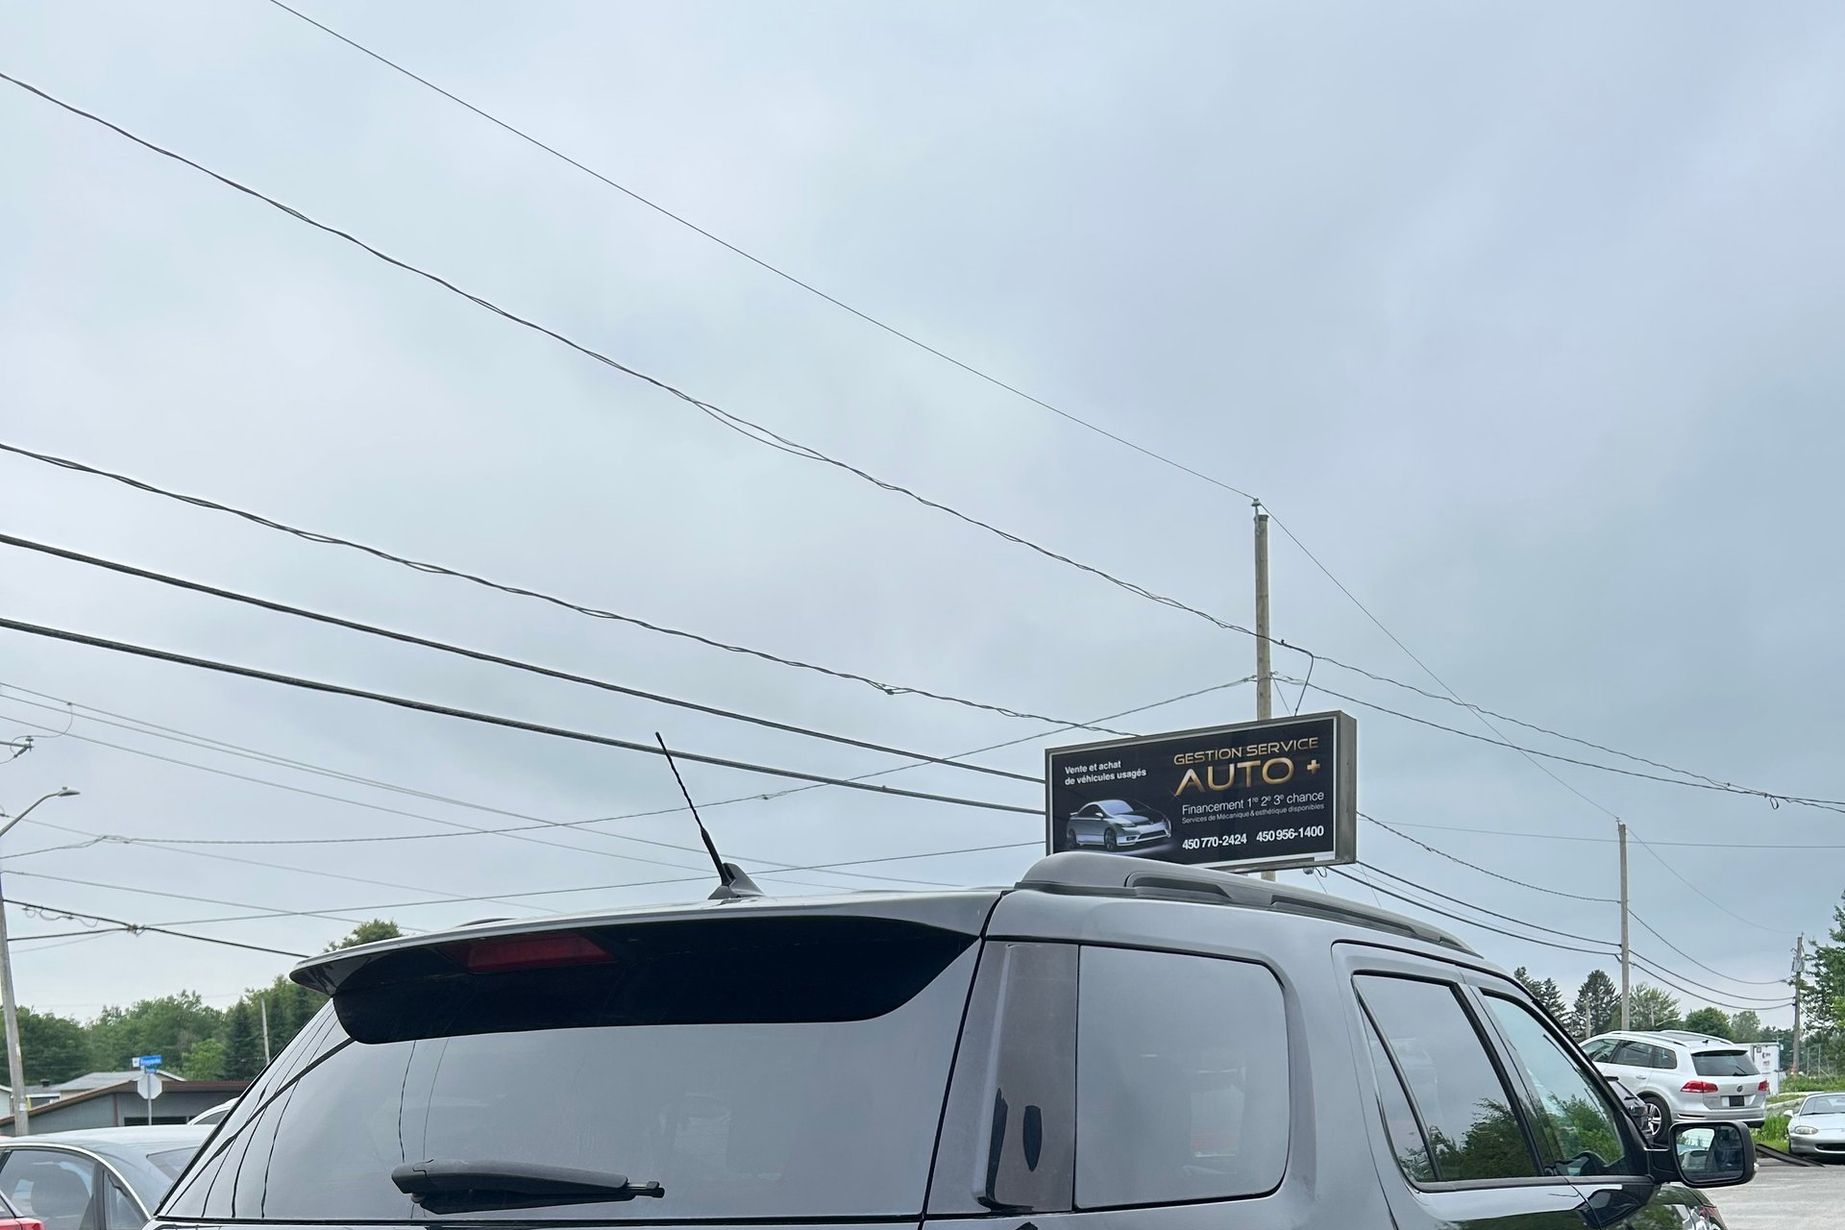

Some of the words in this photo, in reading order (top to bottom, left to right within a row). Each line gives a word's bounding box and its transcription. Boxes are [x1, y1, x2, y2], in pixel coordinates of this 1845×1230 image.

[1174, 747, 1242, 765] GESTION
[1246, 737, 1319, 757] SERVICE
[1064, 765, 1088, 775] Vente
[1088, 763, 1098, 772] et
[1098, 760, 1122, 771] achat
[1064, 777, 1076, 786] de
[1076, 772, 1115, 784] véhicules
[1116, 768, 1147, 780] usagés
[1173, 757, 1295, 797] AUTO
[1182, 799, 1244, 816] Financement
[1286, 791, 1325, 804] chance
[1182, 813, 1208, 824] Services
[1208, 813, 1216, 822] de
[1216, 810, 1250, 821] Mécanique
[1255, 805, 1288, 816] esthétique
[1288, 803, 1325, 814] disponibles
[1182, 838, 1200, 850] 450
[1201, 833, 1247, 848] 770-2424
[1256, 830, 1275, 843] 450
[1276, 825, 1325, 841] 956-1400
